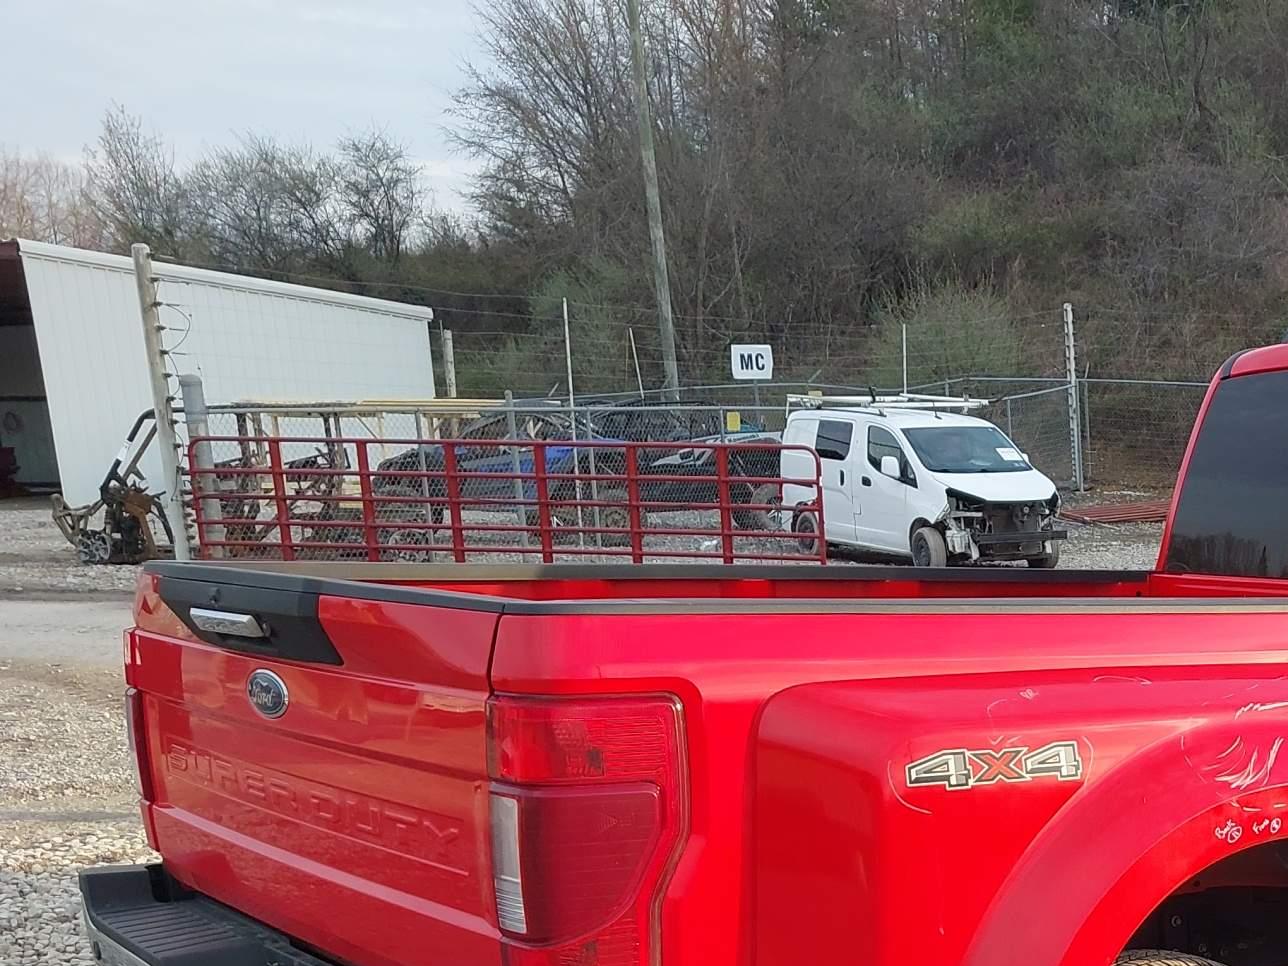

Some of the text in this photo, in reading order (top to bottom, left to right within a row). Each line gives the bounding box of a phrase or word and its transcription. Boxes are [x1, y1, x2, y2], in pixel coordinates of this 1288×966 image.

[740, 353, 765, 370] MC
[167, 742, 459, 854] SUPER DUTY
